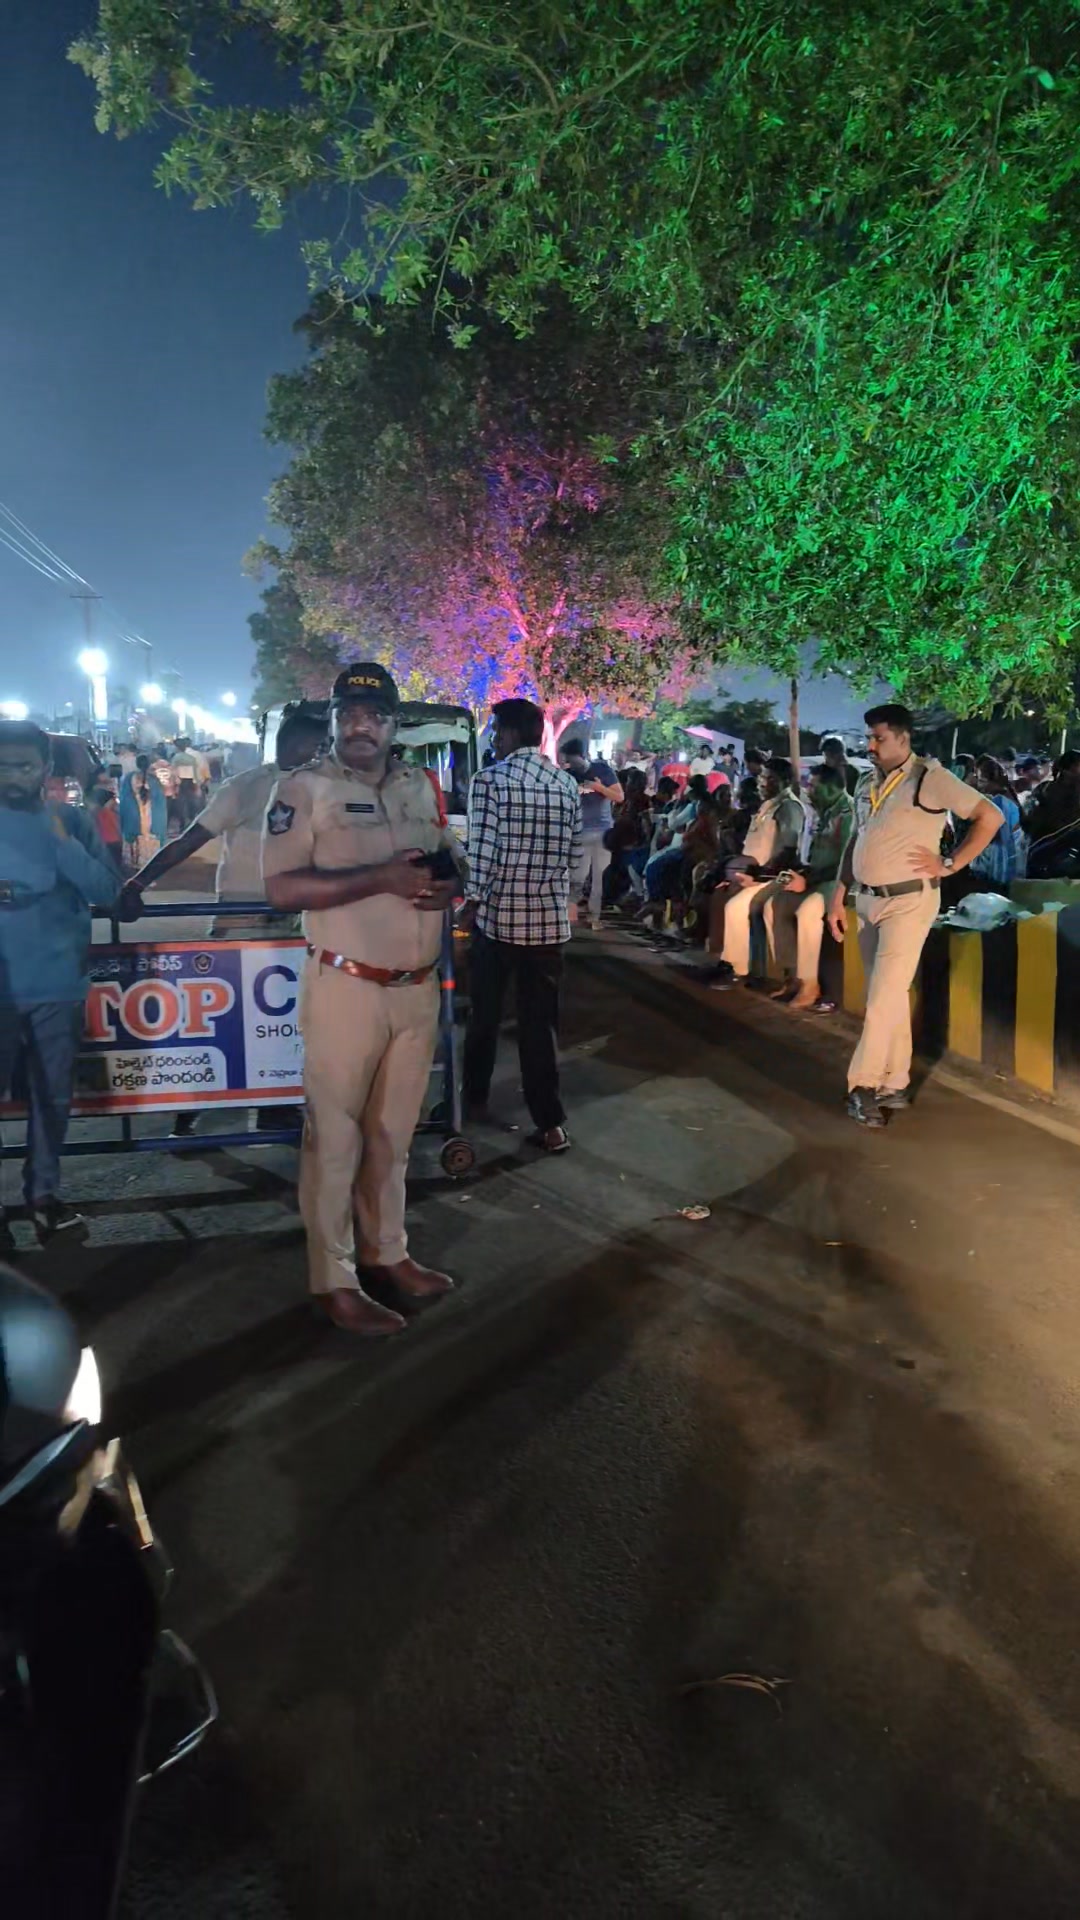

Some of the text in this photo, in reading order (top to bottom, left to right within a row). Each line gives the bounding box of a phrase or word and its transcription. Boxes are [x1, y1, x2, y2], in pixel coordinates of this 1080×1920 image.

[348, 676, 381, 688] POLICE
[253, 965, 298, 1017] C
[82, 977, 235, 1042] TOP
[112, 1073, 148, 1091] రక్షణ
